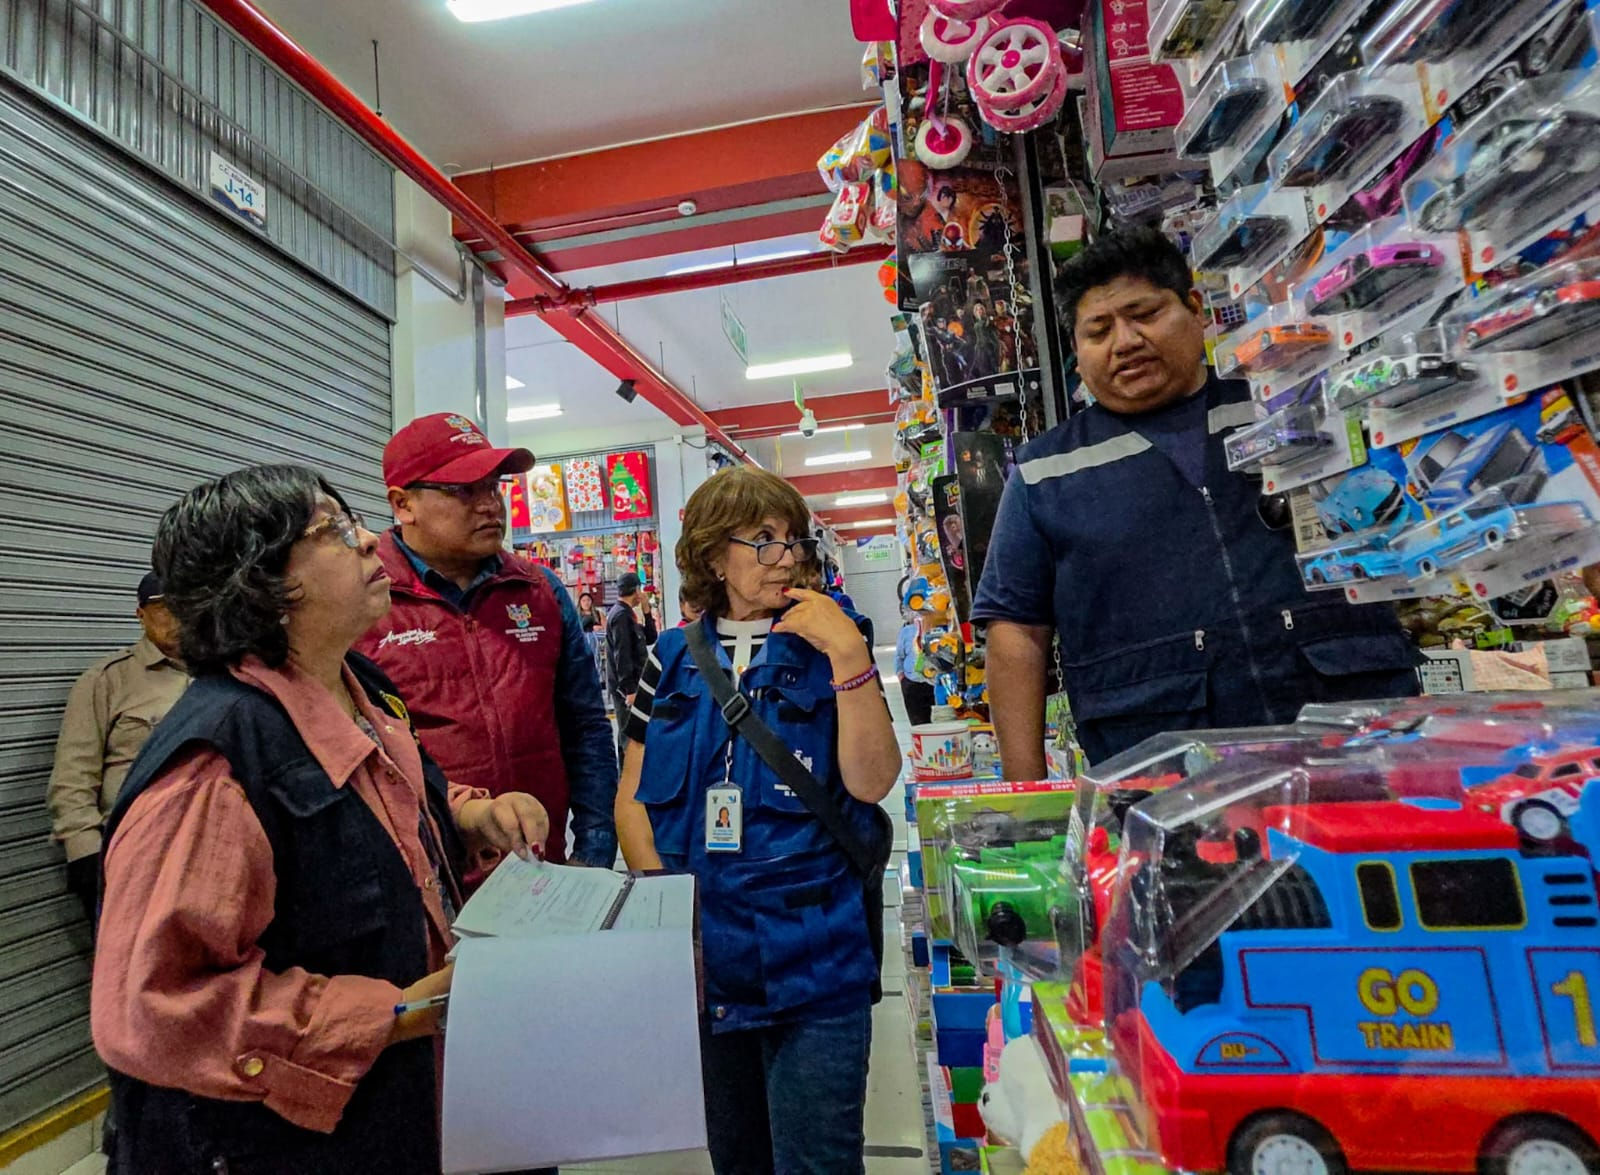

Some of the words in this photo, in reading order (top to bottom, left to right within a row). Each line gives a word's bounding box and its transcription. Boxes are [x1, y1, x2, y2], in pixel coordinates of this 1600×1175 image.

[225, 179, 253, 206] J-14
[1358, 968, 1438, 1016] GO
[1552, 971, 1597, 1047] 1
[1358, 1022, 1453, 1050] TRAIN
